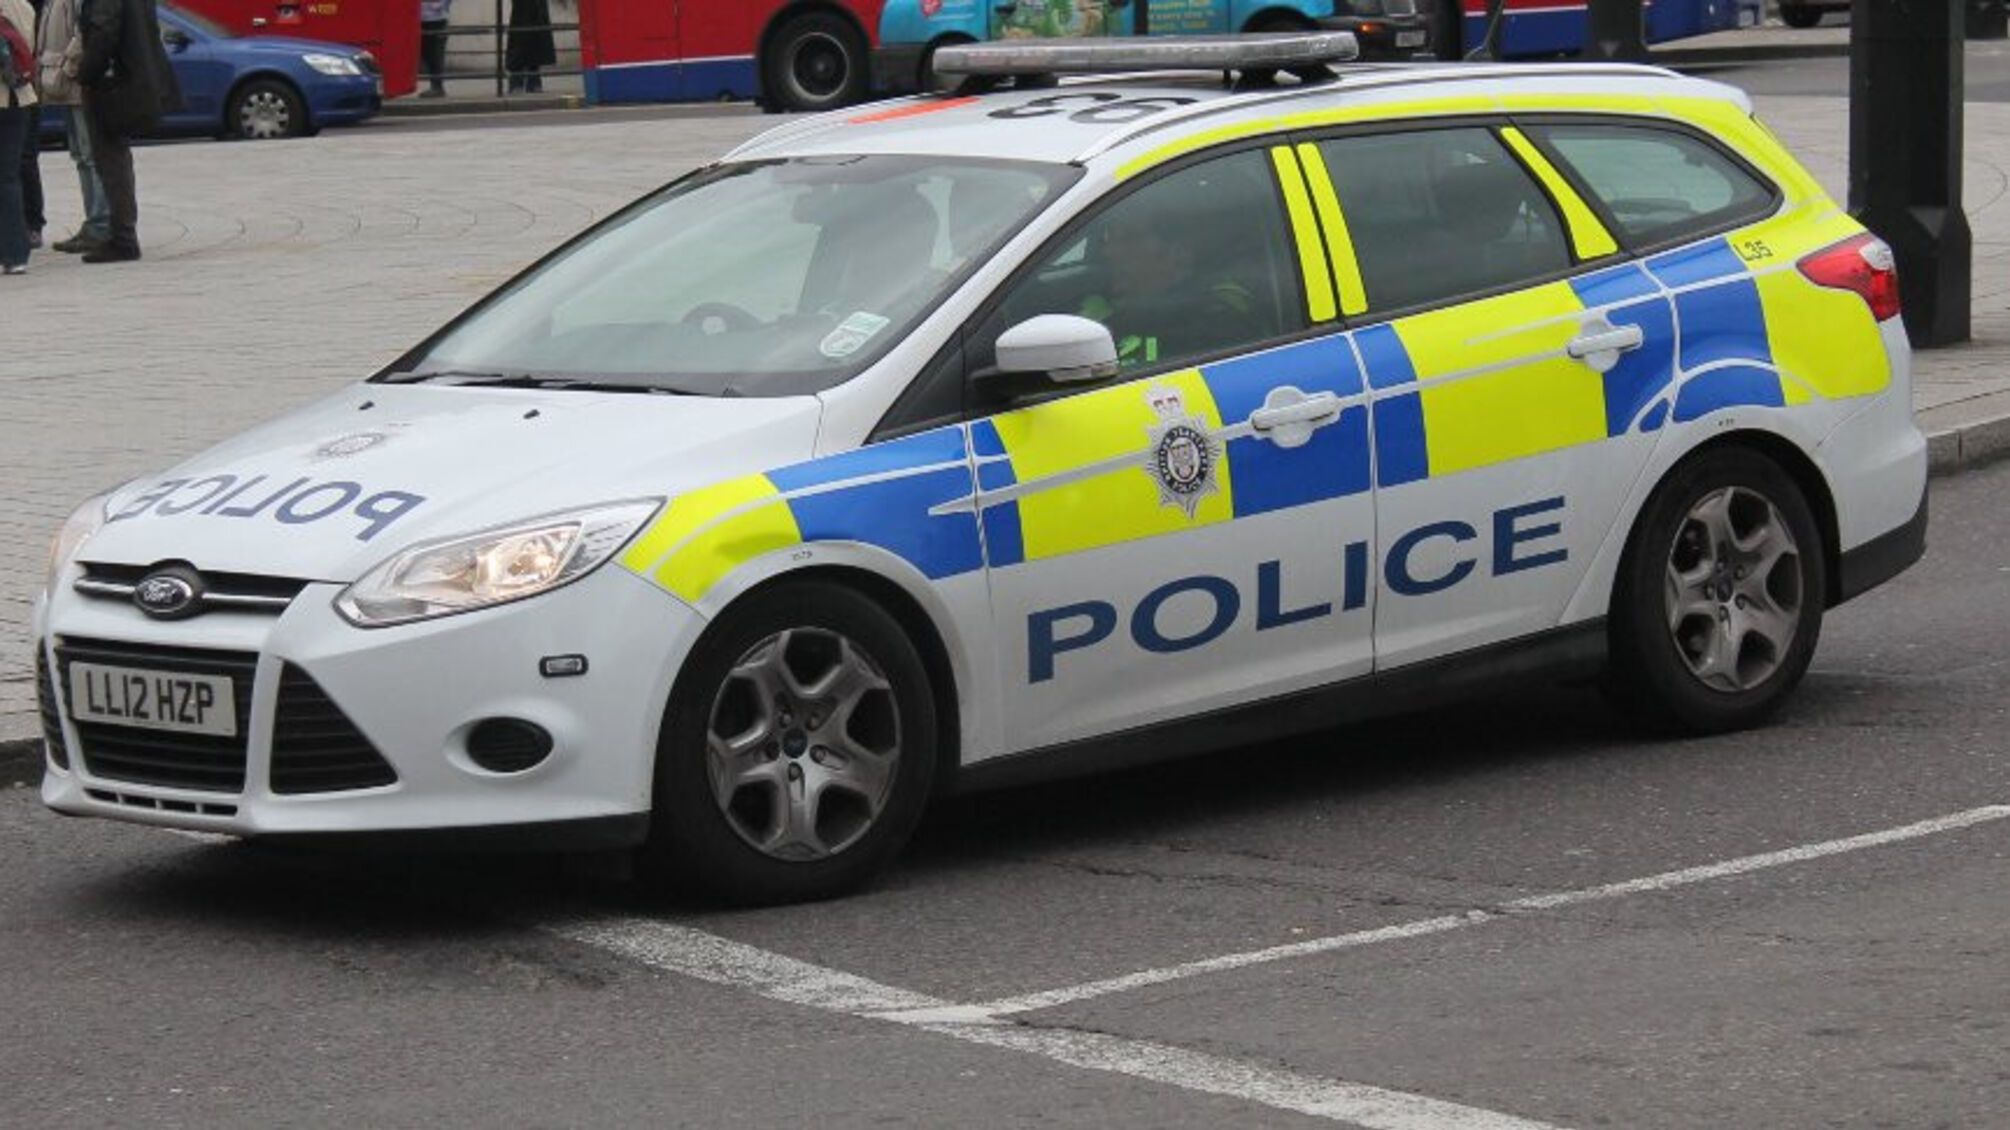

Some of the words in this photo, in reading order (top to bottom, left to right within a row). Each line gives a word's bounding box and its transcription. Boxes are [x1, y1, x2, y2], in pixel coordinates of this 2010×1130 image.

[1733, 240, 1773, 261] L35
[1027, 497, 1569, 684] POLICE
[86, 670, 150, 720] LL12
[155, 678, 214, 725] HZP
